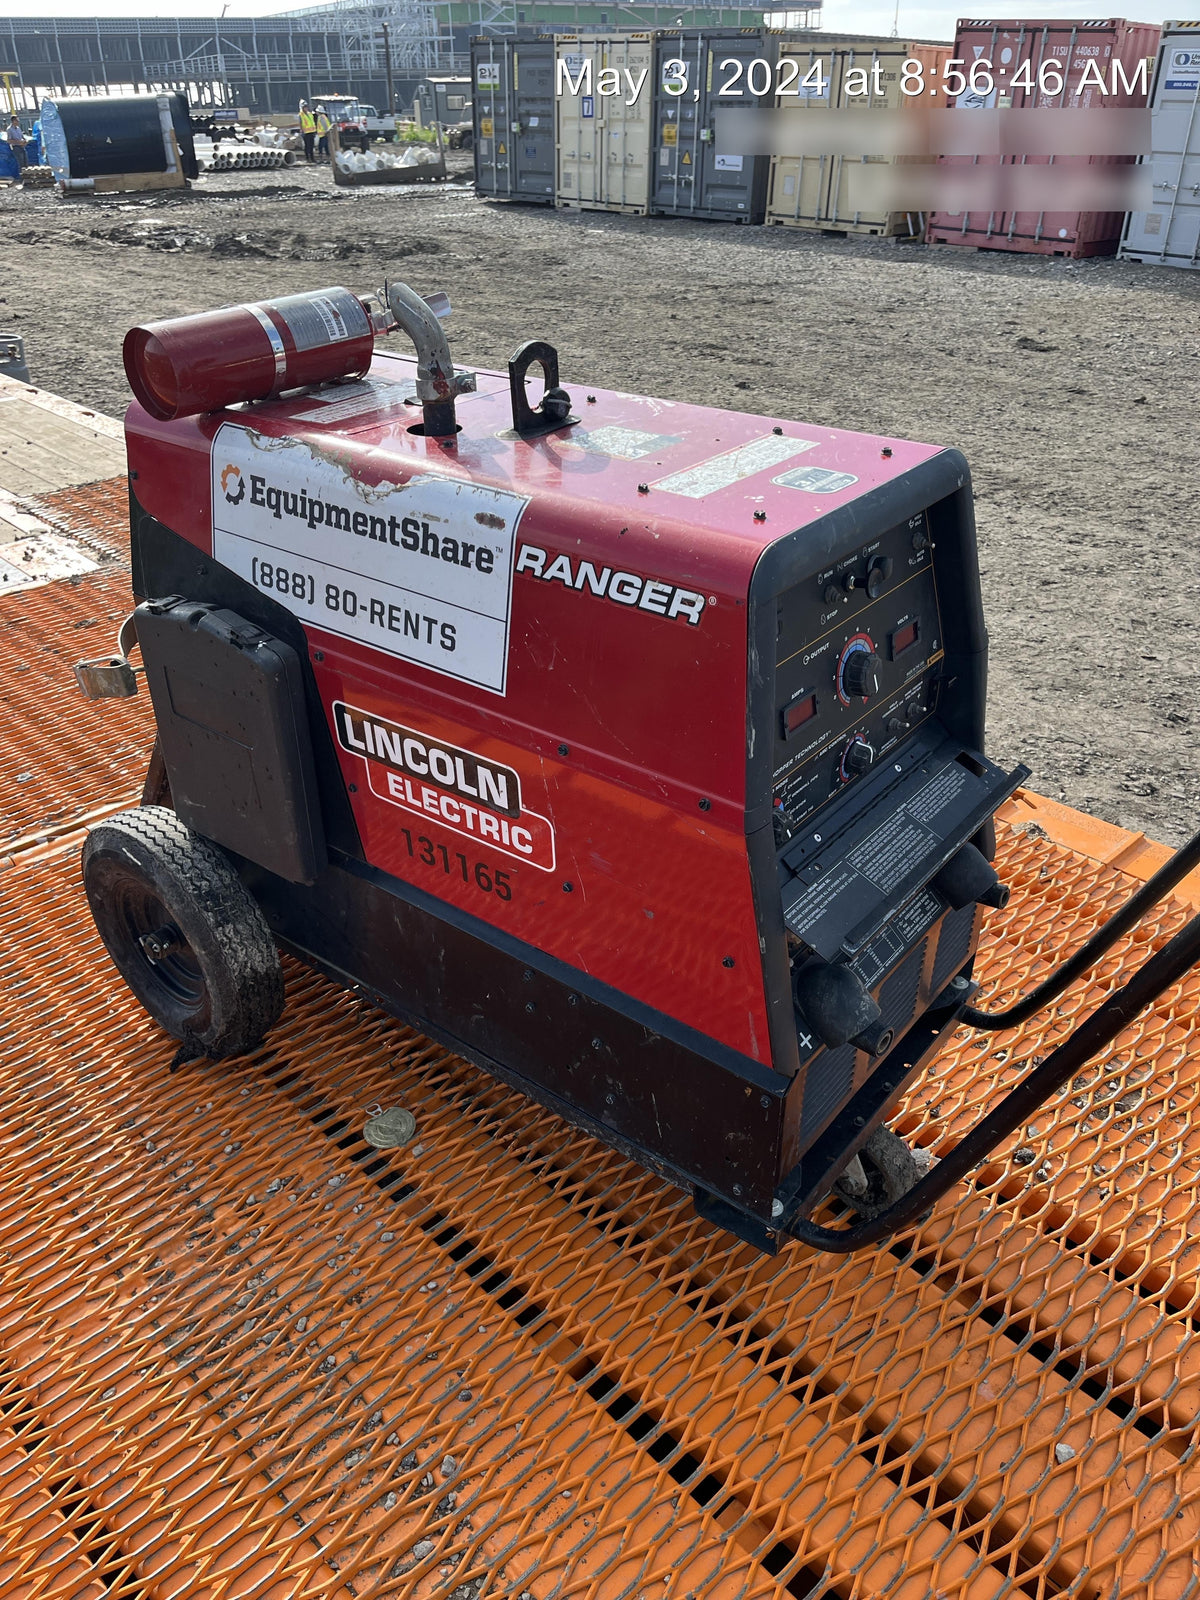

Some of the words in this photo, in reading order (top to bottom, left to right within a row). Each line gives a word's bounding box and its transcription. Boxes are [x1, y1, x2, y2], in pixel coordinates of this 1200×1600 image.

[1073, 59, 1087, 69] 45G
[251, 556, 315, 605] (888)
[325, 584, 457, 652] 80-RENTS
[826, 609, 838, 620] STOP
[810, 641, 830, 659] OUTPUT
[343, 711, 509, 810] LINCOLN
[386, 771, 533, 854] ELECTRIC
[401, 828, 513, 901] 131165
